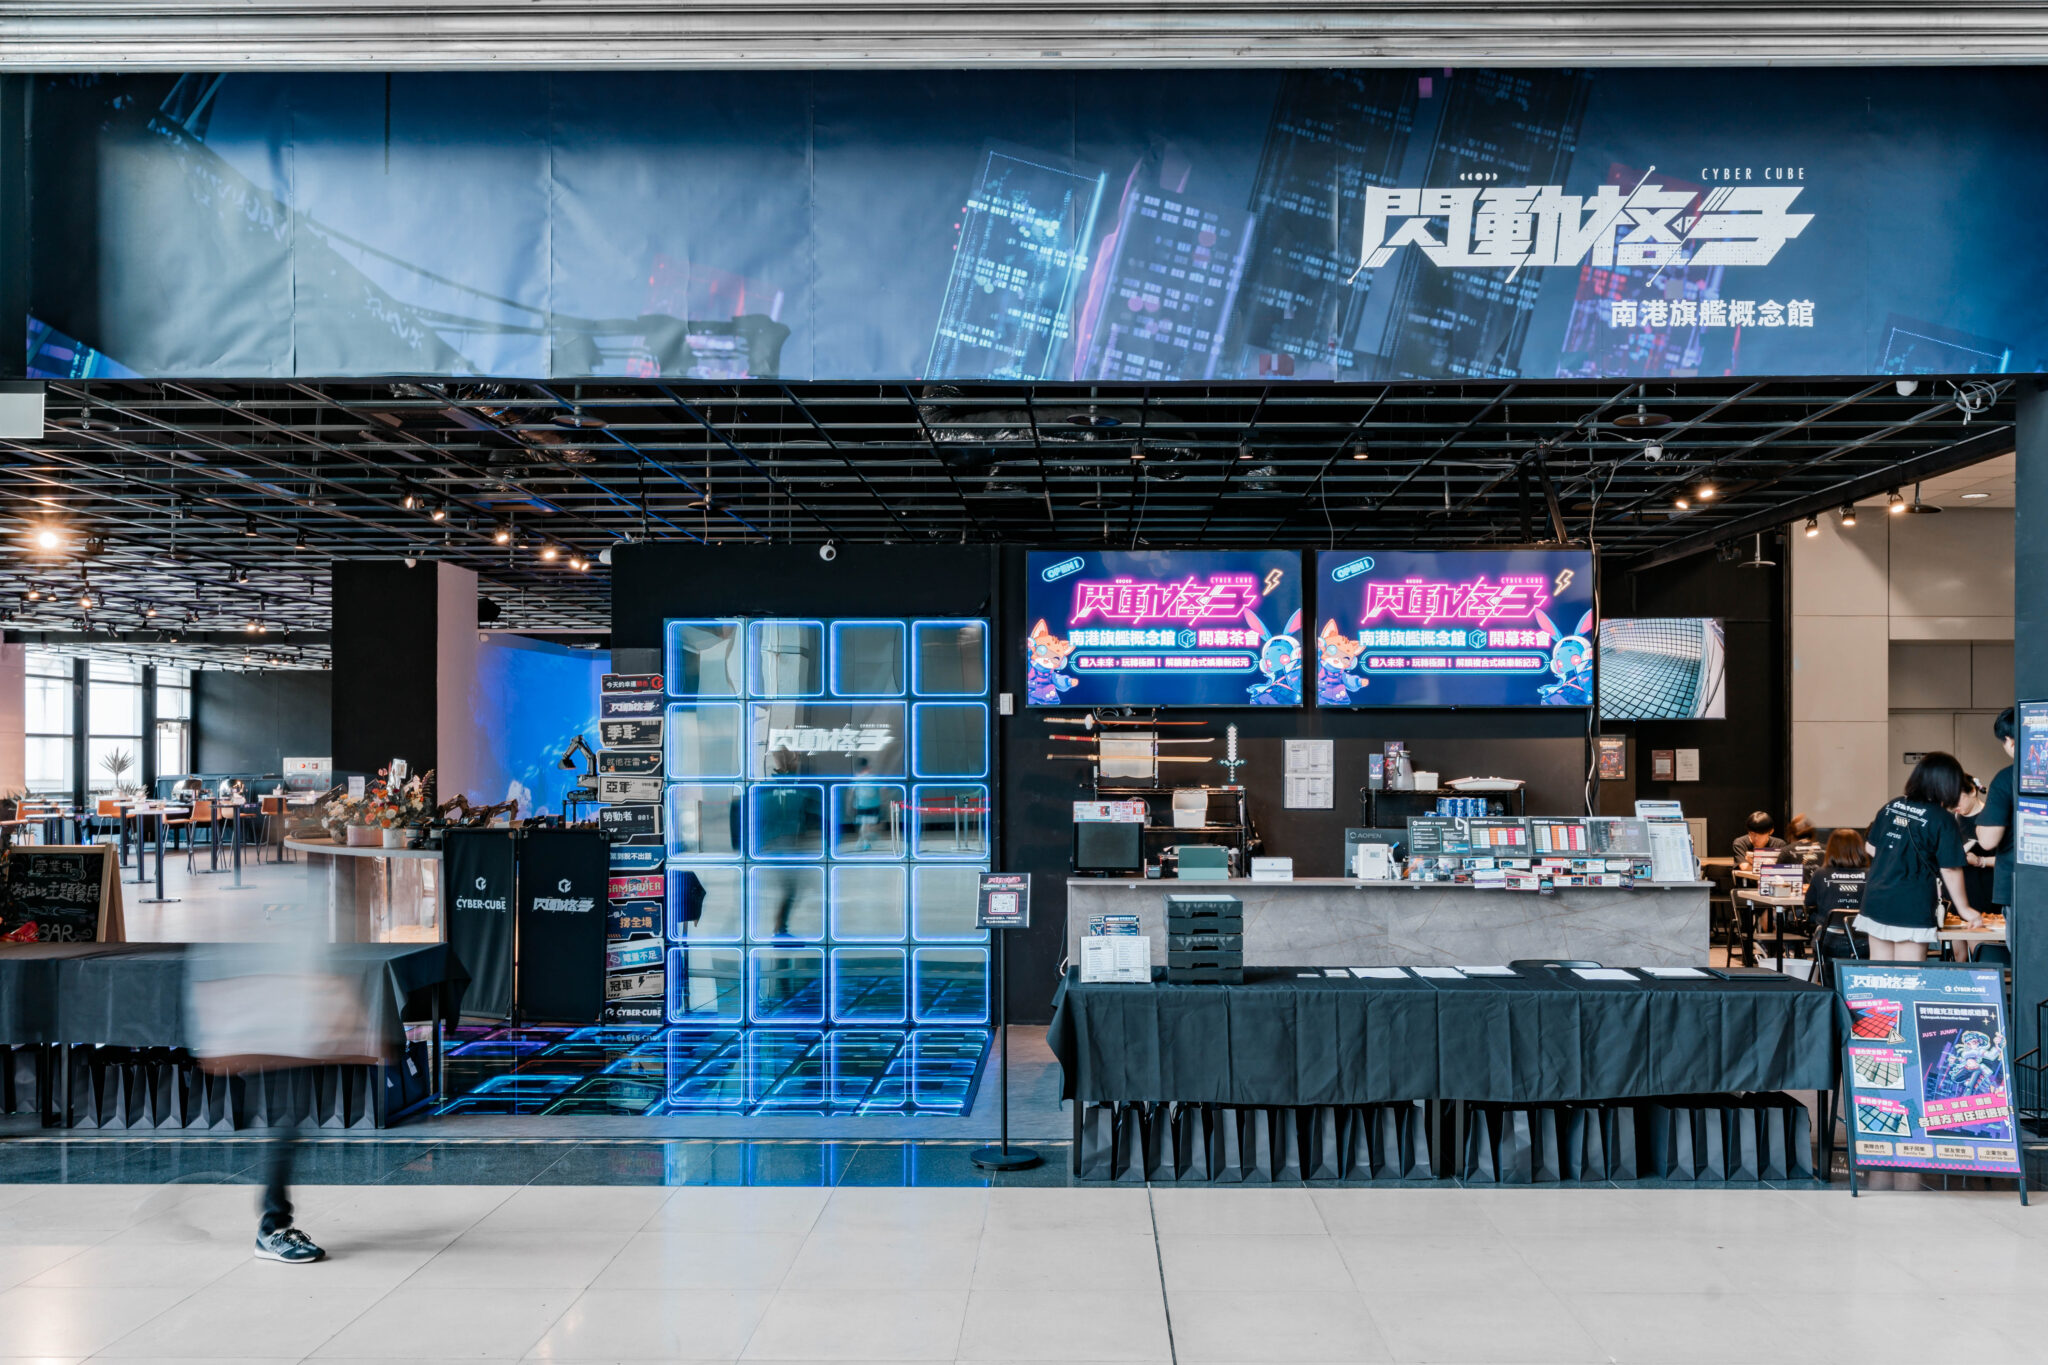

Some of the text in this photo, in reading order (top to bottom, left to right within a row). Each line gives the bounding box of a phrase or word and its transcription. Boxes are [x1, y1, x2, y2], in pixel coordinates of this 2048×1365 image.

[1702, 166, 1805, 180] CYBER CUBE
[1350, 178, 1815, 274] 閃動格子
[1611, 299, 1815, 328] 南港旗艦概念館
[1073, 578, 1257, 624] 閃動格子
[1363, 578, 1547, 624] 閃動格子
[1069, 630, 1260, 647] 南港旗艦概念館 開幕茶會
[1359, 630, 1551, 647] 南港旗艦概念館 開幕茶會
[766, 728, 895, 752] 閃動格子
[605, 781, 632, 794] 亞軍
[602, 810, 633, 822] 勞動者
[34, 859, 73, 873] 營業中
[455, 897, 507, 911] CYBER-CUBE
[532, 896, 596, 914] 閃動格子
[609, 979, 633, 992] 冠軍
[616, 1008, 662, 1017] CYBER-CUBE
